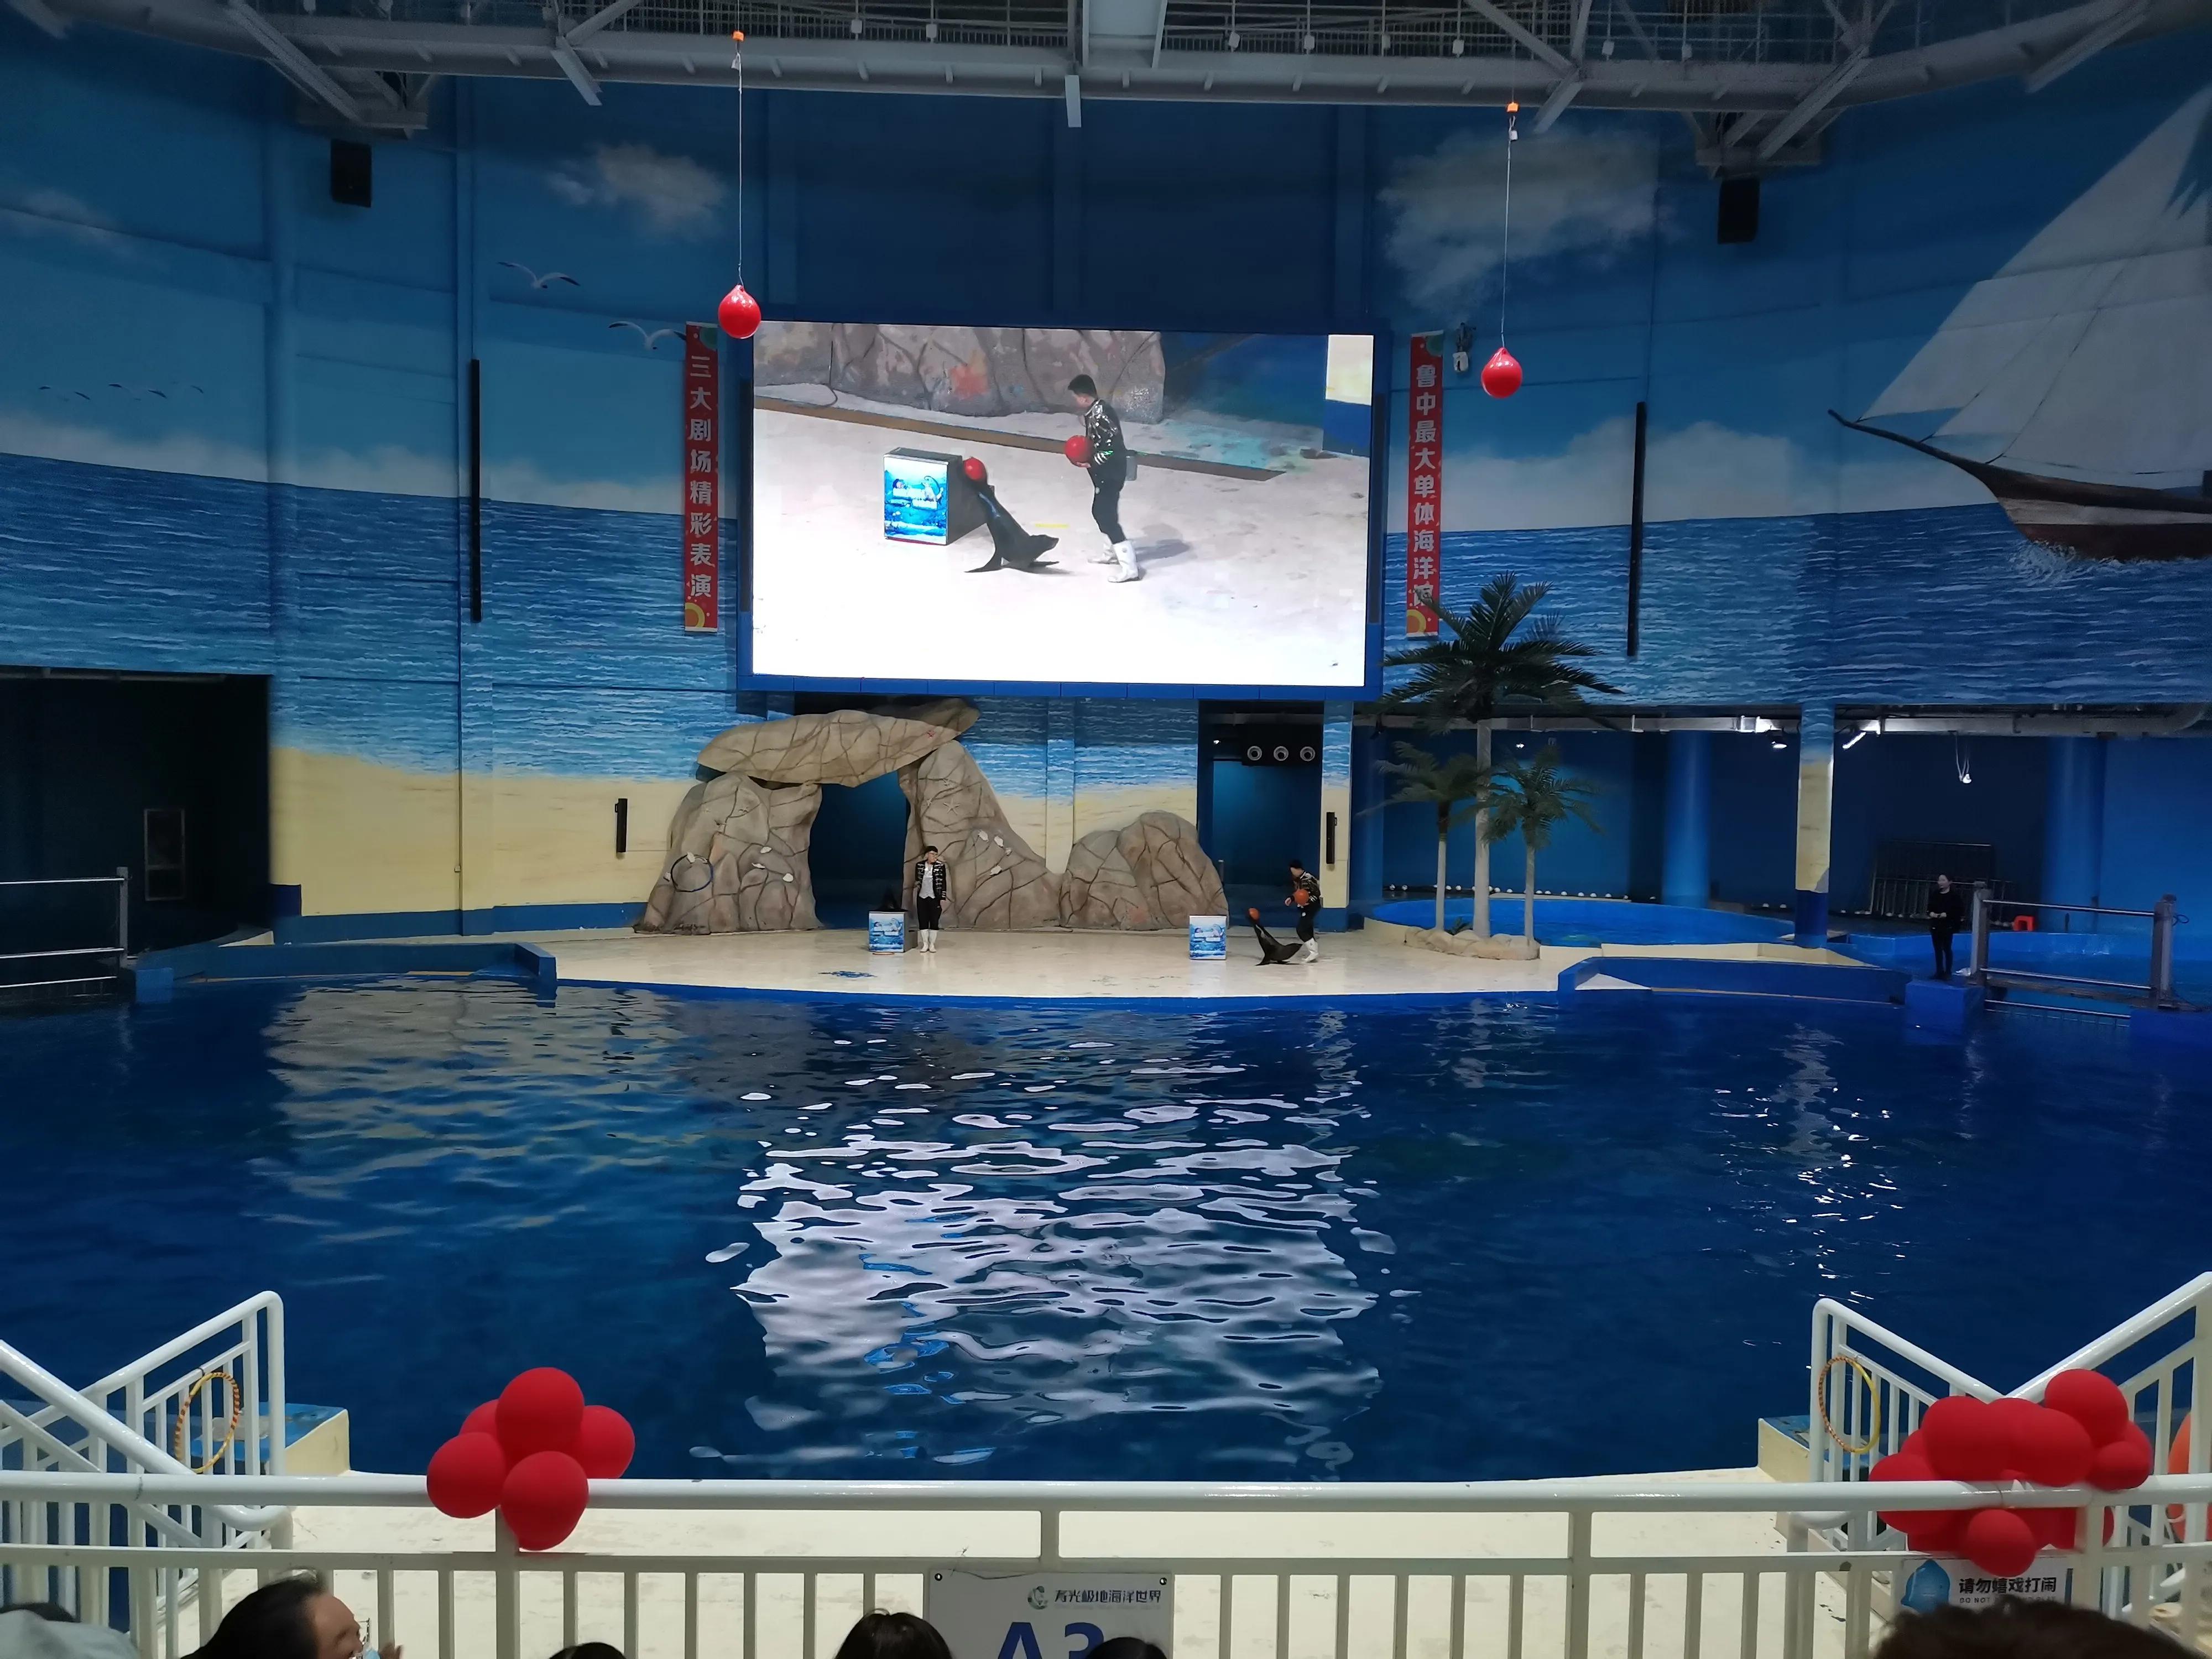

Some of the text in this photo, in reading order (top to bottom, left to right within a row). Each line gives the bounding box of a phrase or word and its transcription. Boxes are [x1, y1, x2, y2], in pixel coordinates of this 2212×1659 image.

[690, 355, 712, 598] 三大剧场精彩表演
[1413, 364, 1437, 607] 鲁中最大单体海洋馆
[1959, 1577, 2057, 1594] 请勿嬉戏打闹
